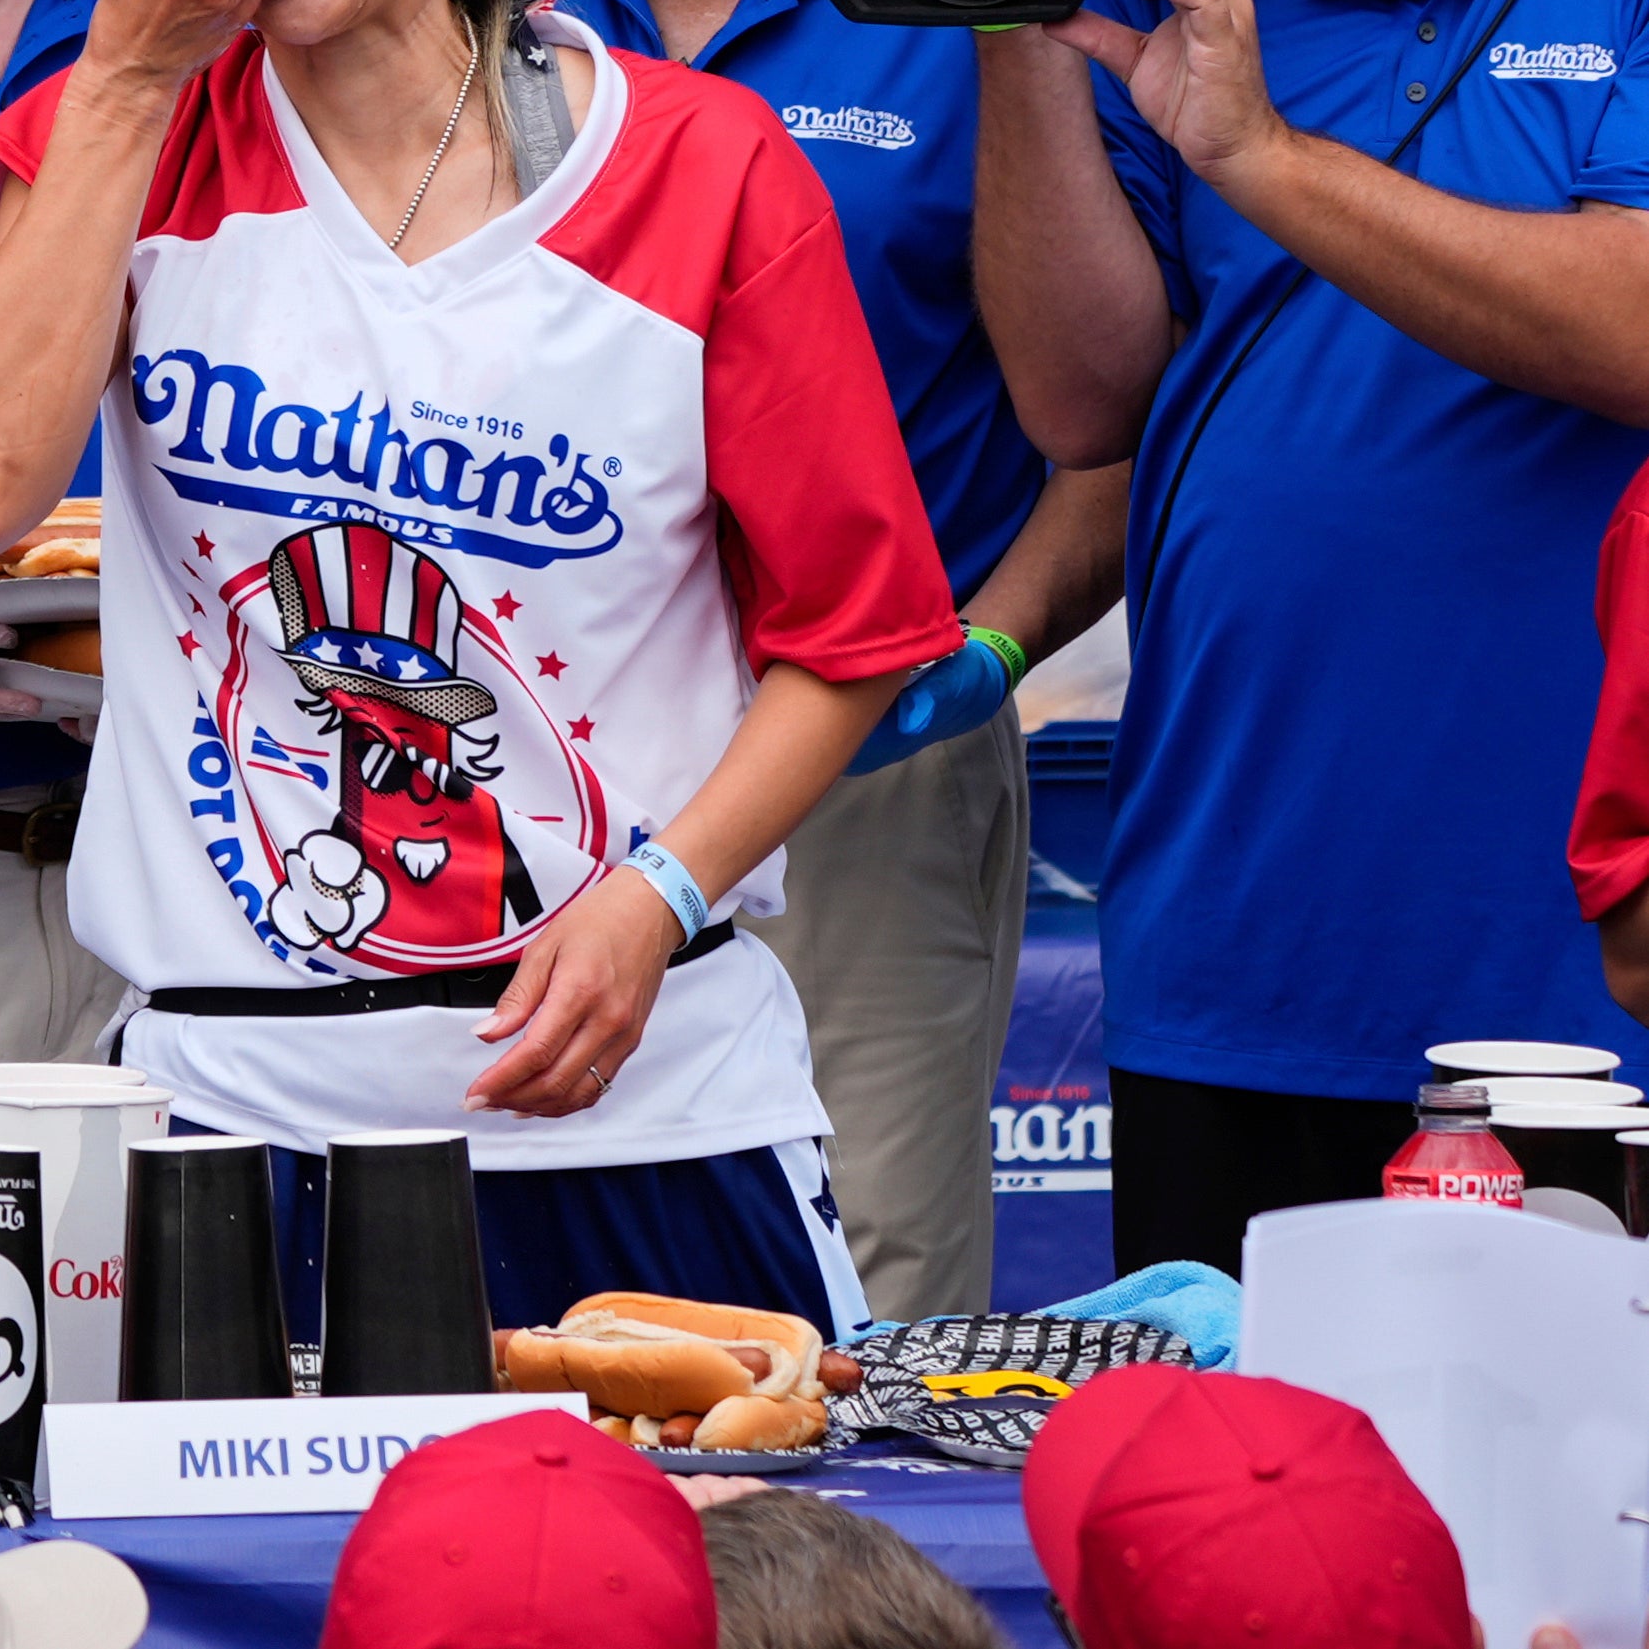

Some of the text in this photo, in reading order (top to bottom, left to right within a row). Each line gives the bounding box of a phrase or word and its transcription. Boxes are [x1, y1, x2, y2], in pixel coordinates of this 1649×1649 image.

[1489, 42, 1614, 71] Nathan's
[782, 105, 915, 141] Nathan's
[410, 400, 525, 441] Since 1916
[131, 349, 611, 535] Nathan's
[289, 498, 455, 544] FAMOUS
[49, 1258, 124, 1300] Cok
[179, 1437, 290, 1479] MIKI
